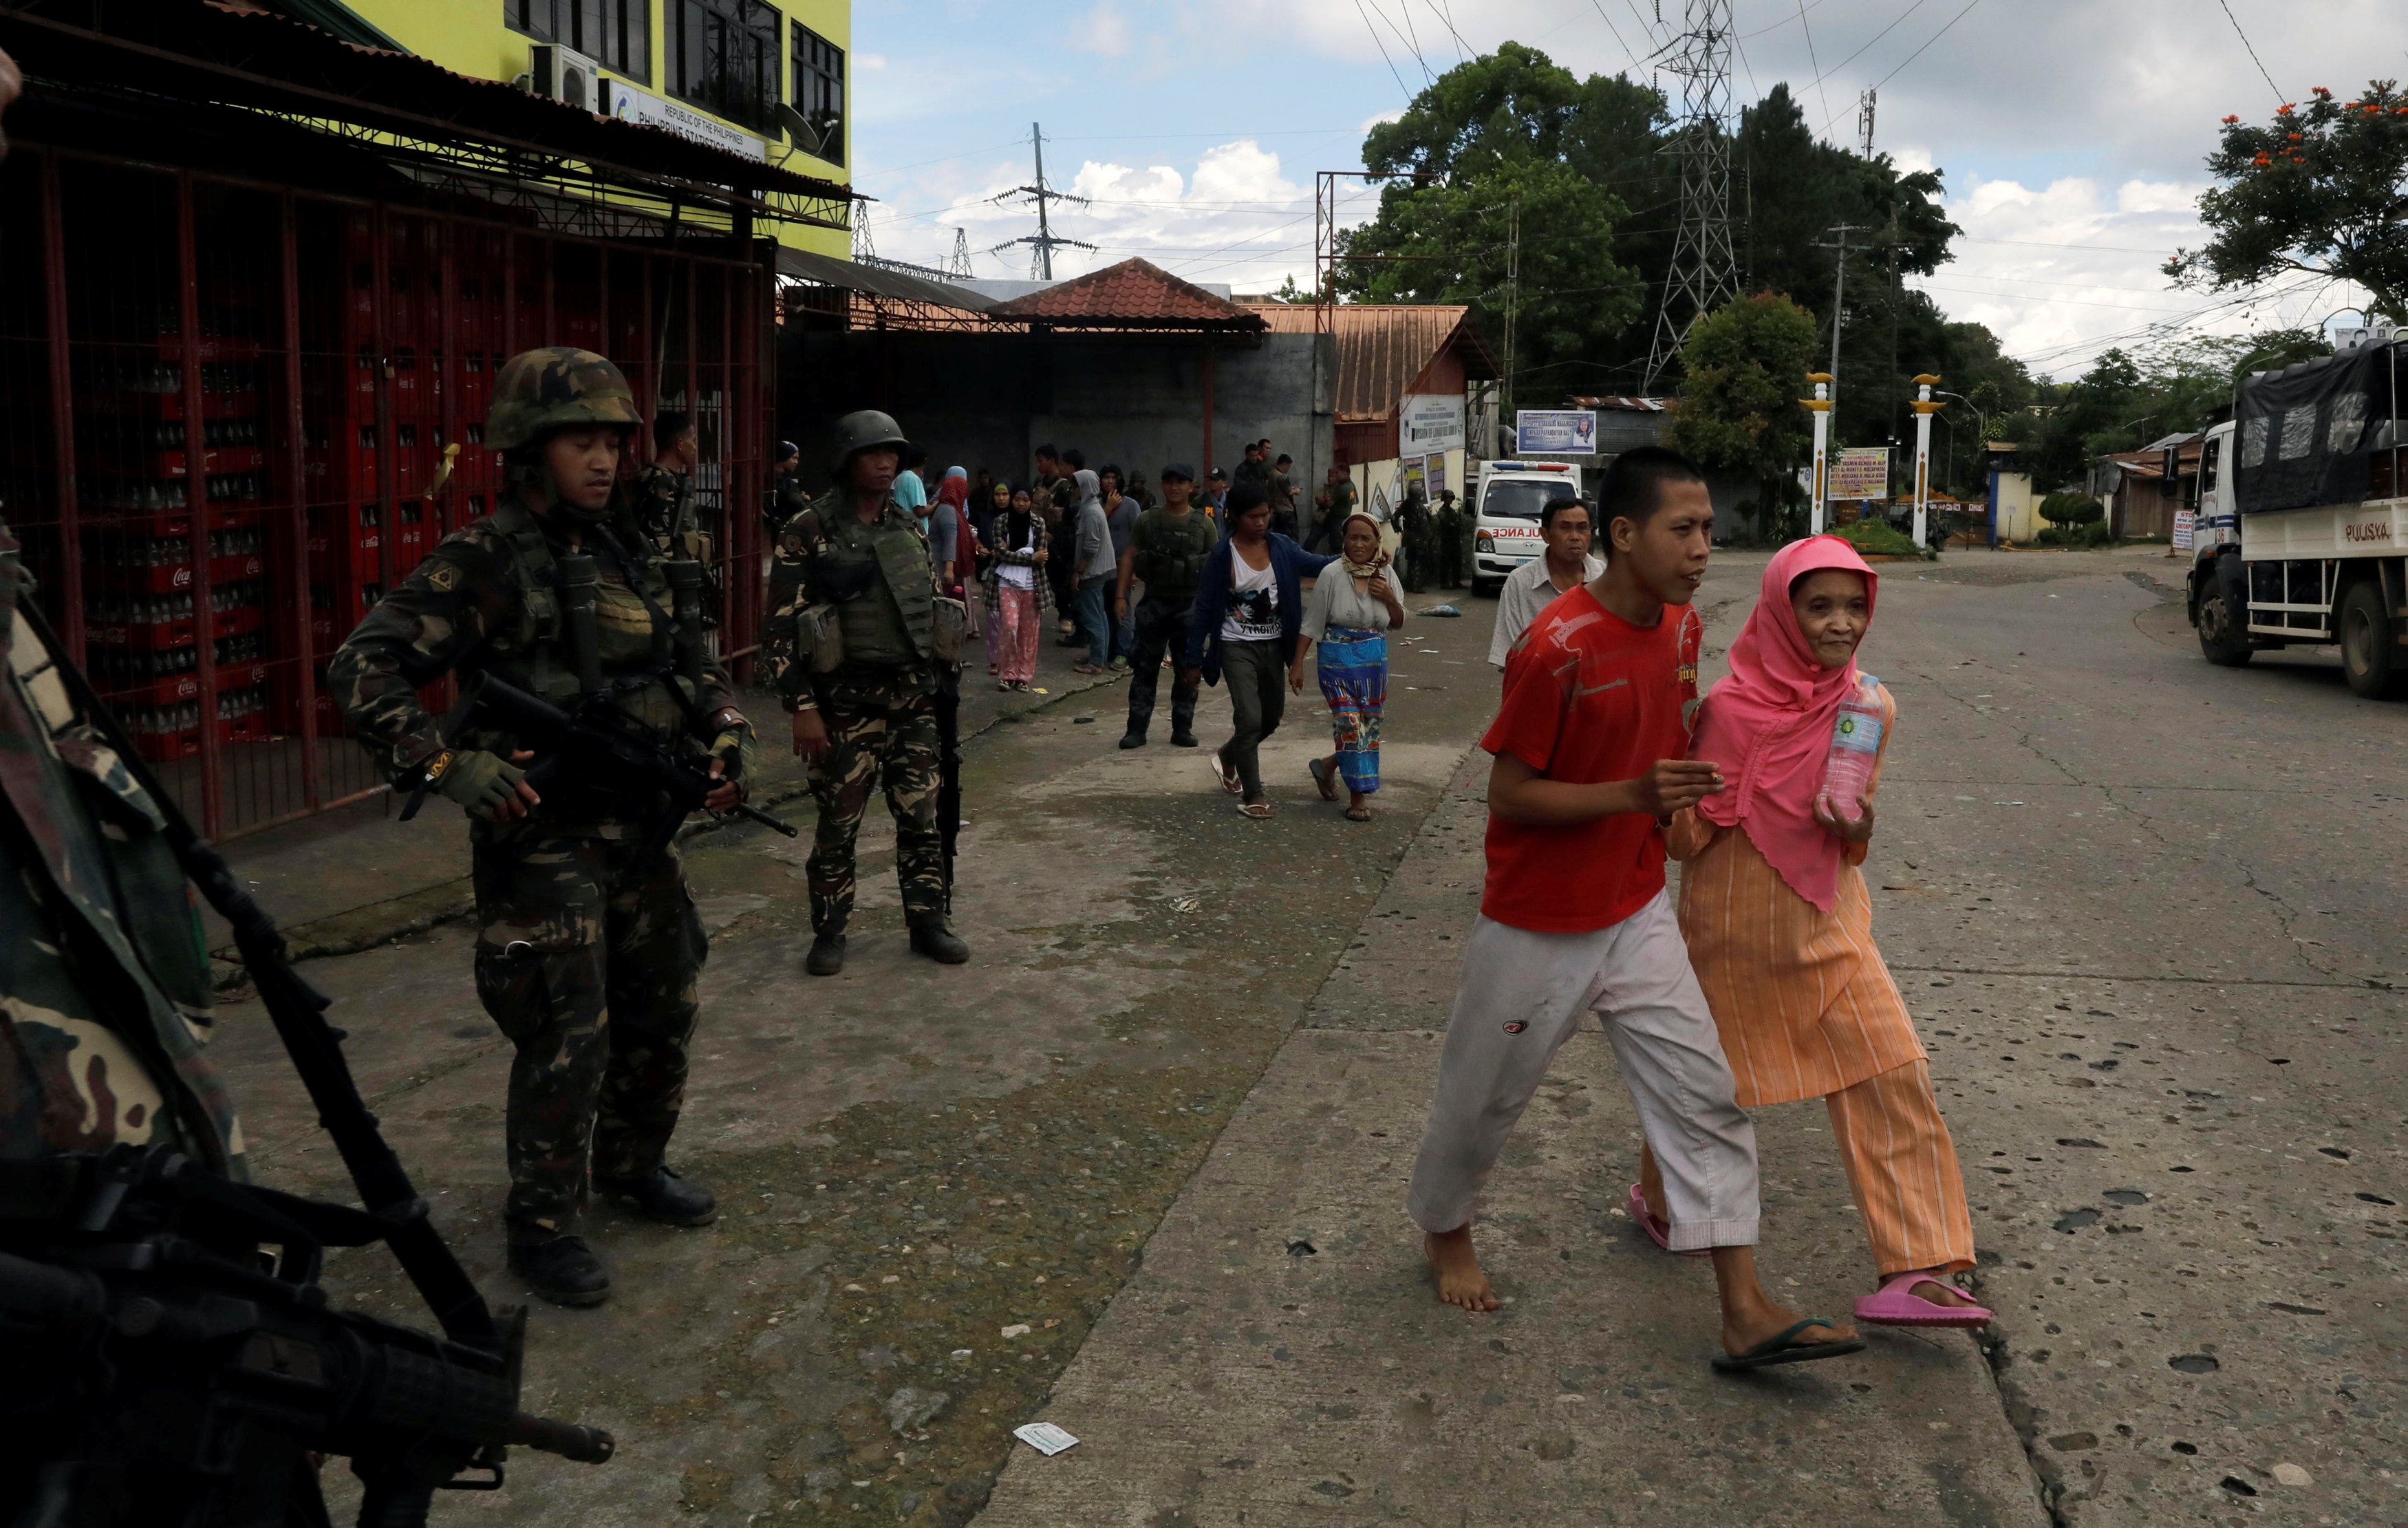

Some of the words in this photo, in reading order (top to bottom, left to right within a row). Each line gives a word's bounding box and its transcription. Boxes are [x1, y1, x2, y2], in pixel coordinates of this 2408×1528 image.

[639, 111, 683, 138] PHILIPPINE
[665, 105, 693, 125] REPUBLIC
[694, 118, 702, 129] OF
[702, 120, 713, 133] THE
[713, 125, 743, 145] PHILIPPINES
[2217, 528, 2224, 543] 36
[2346, 522, 2389, 542] PULISYA
